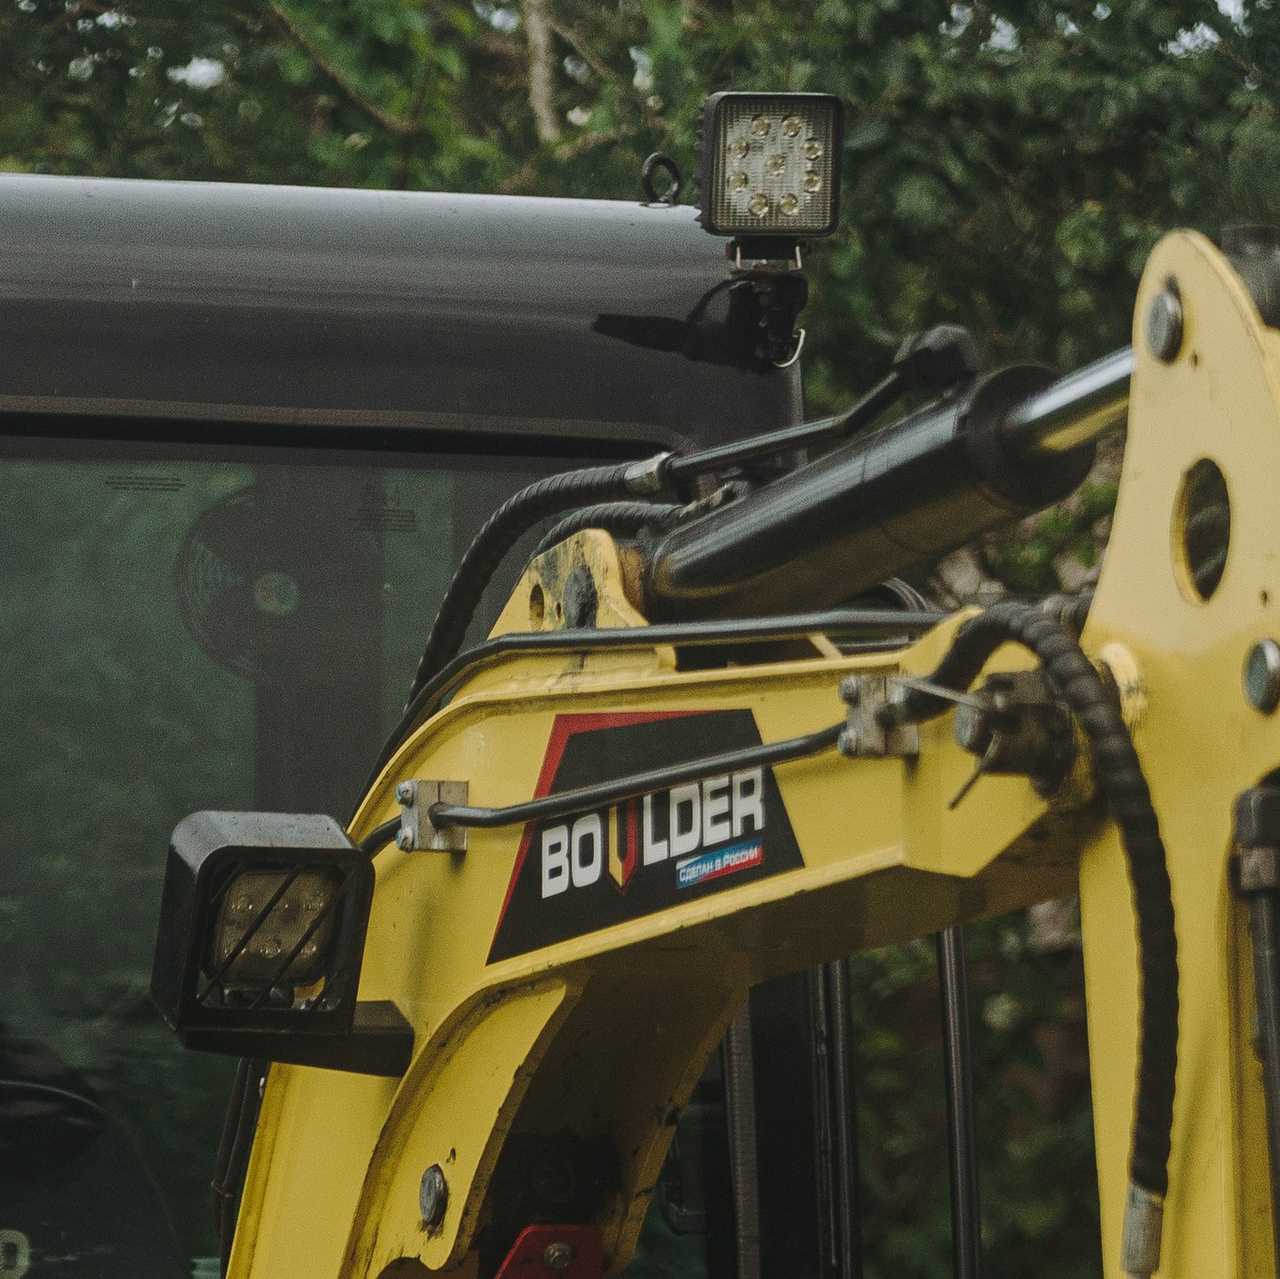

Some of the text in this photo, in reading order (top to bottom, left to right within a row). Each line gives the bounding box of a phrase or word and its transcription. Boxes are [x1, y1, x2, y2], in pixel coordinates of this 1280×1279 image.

[541, 768, 766, 899] BOULDER
[679, 860, 713, 882] СДЕЛАН
[723, 847, 758, 868] РОССИИ
